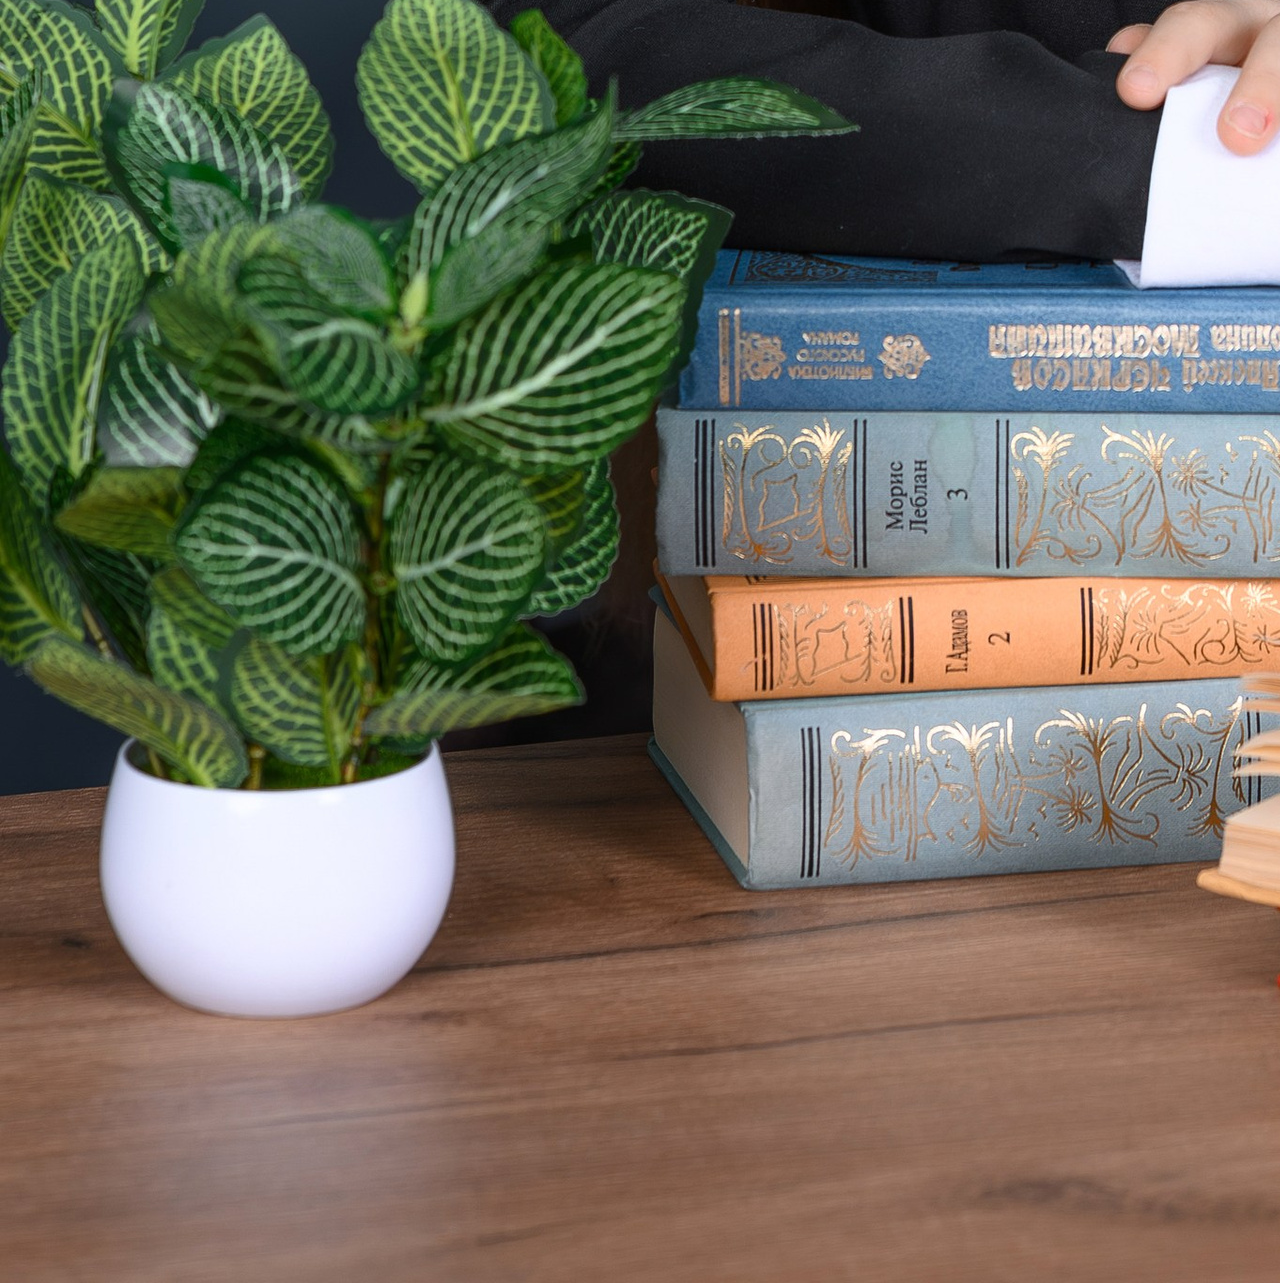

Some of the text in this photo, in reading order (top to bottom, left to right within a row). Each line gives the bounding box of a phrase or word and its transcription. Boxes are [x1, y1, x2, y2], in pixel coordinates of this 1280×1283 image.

[802, 330, 860, 346] РОМАНА
[988, 324, 1200, 360] МОСКВИТИНА
[795, 347, 865, 364] РУССКОГО
[787, 364, 873, 381] БИБЛИОТЕКА
[1011, 359, 1172, 394] ЧЕРКАСОВ
[885, 460, 909, 531] Морис
[909, 459, 928, 534] Леблан
[946, 488, 968, 501] 3
[987, 632, 1011, 645] 2
